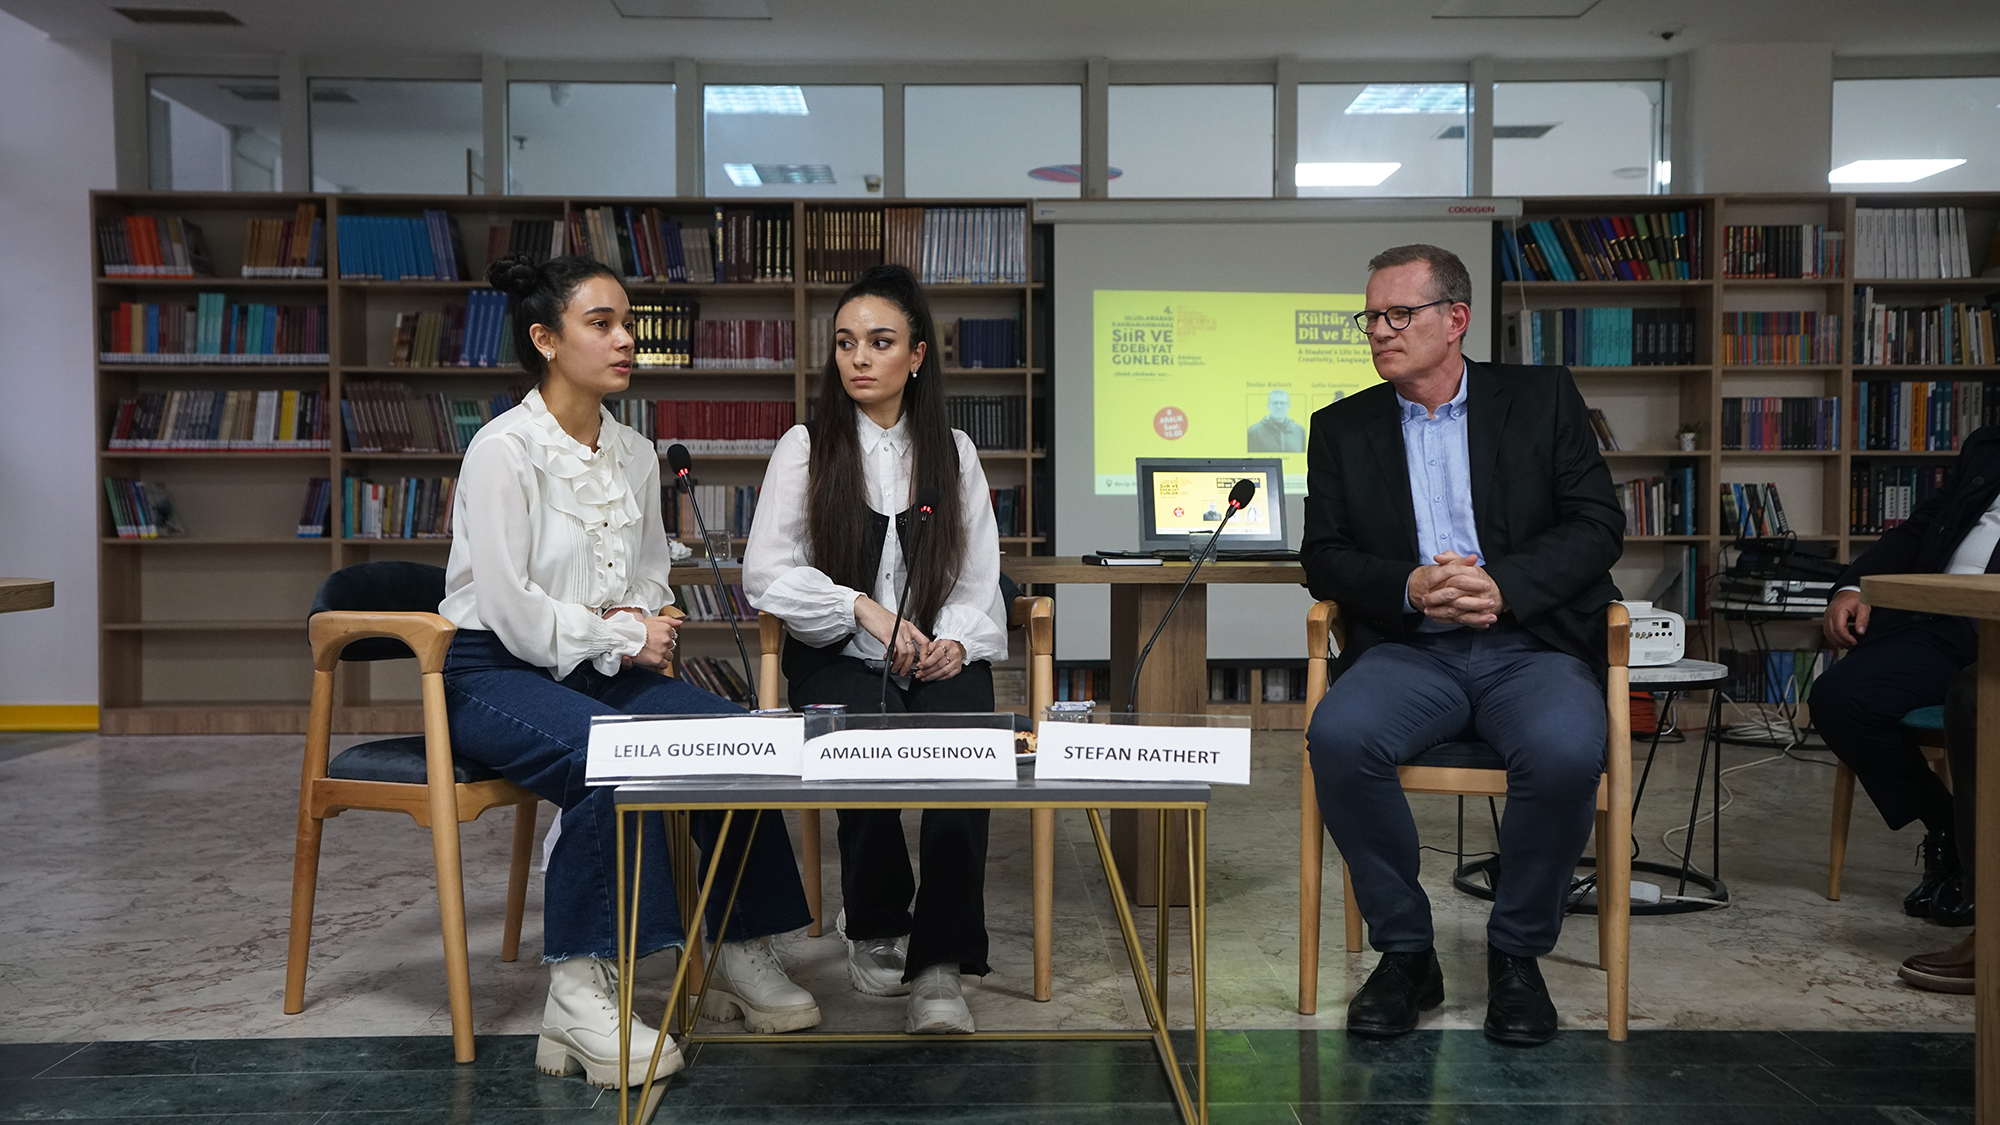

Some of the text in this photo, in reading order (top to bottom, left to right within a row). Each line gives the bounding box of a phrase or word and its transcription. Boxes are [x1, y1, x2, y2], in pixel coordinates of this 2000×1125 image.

[1448, 205, 1496, 214] CODEGEN
[1298, 312, 1350, 327] Kültür,
[1151, 329, 1173, 343] VE
[1298, 327, 1320, 341] Dil
[1322, 330, 1340, 341] ve
[1298, 356, 1336, 364] Creativity,
[1160, 414, 1184, 424] ARALIK
[614, 742, 777, 758] LEILA GUSEINOVA
[820, 746, 997, 760] AMALIIA GUSEINOVA
[1064, 746, 1221, 765] STEFAN RATHERT
